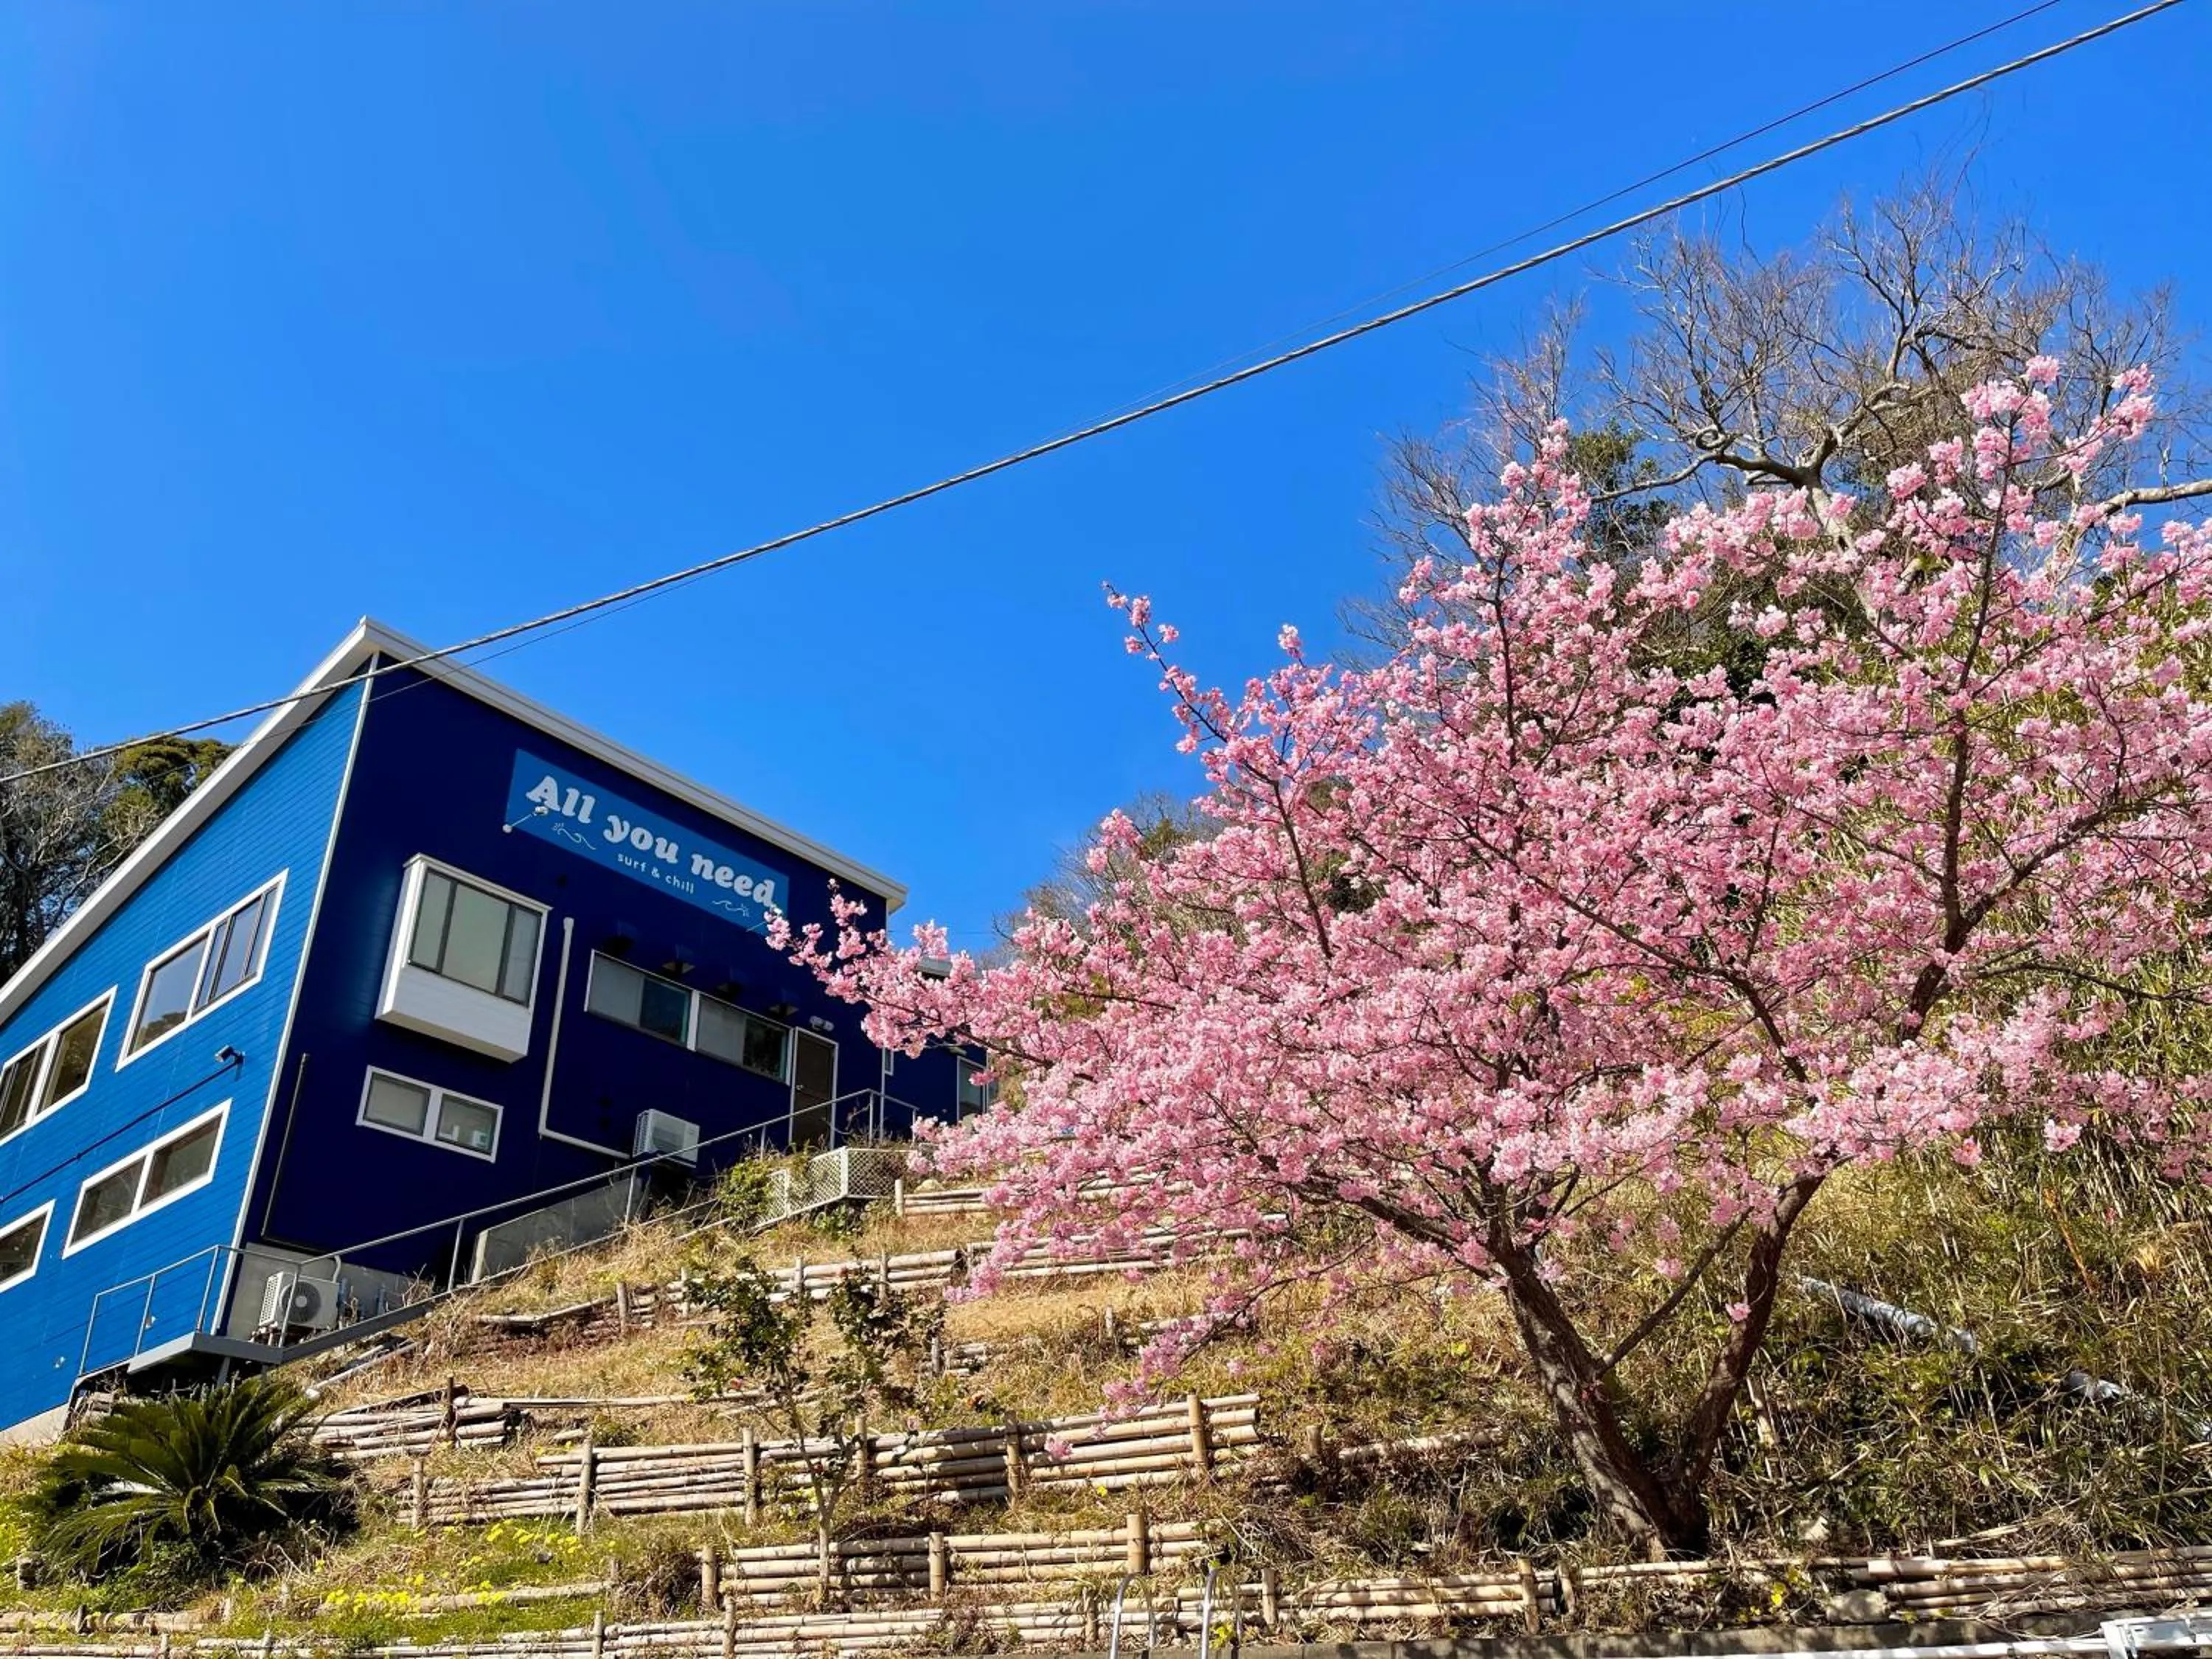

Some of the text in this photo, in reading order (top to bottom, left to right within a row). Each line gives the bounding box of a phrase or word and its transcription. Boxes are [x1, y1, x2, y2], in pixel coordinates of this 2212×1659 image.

[526, 776, 776, 906] All you need
[618, 853, 695, 894] surf & chill
